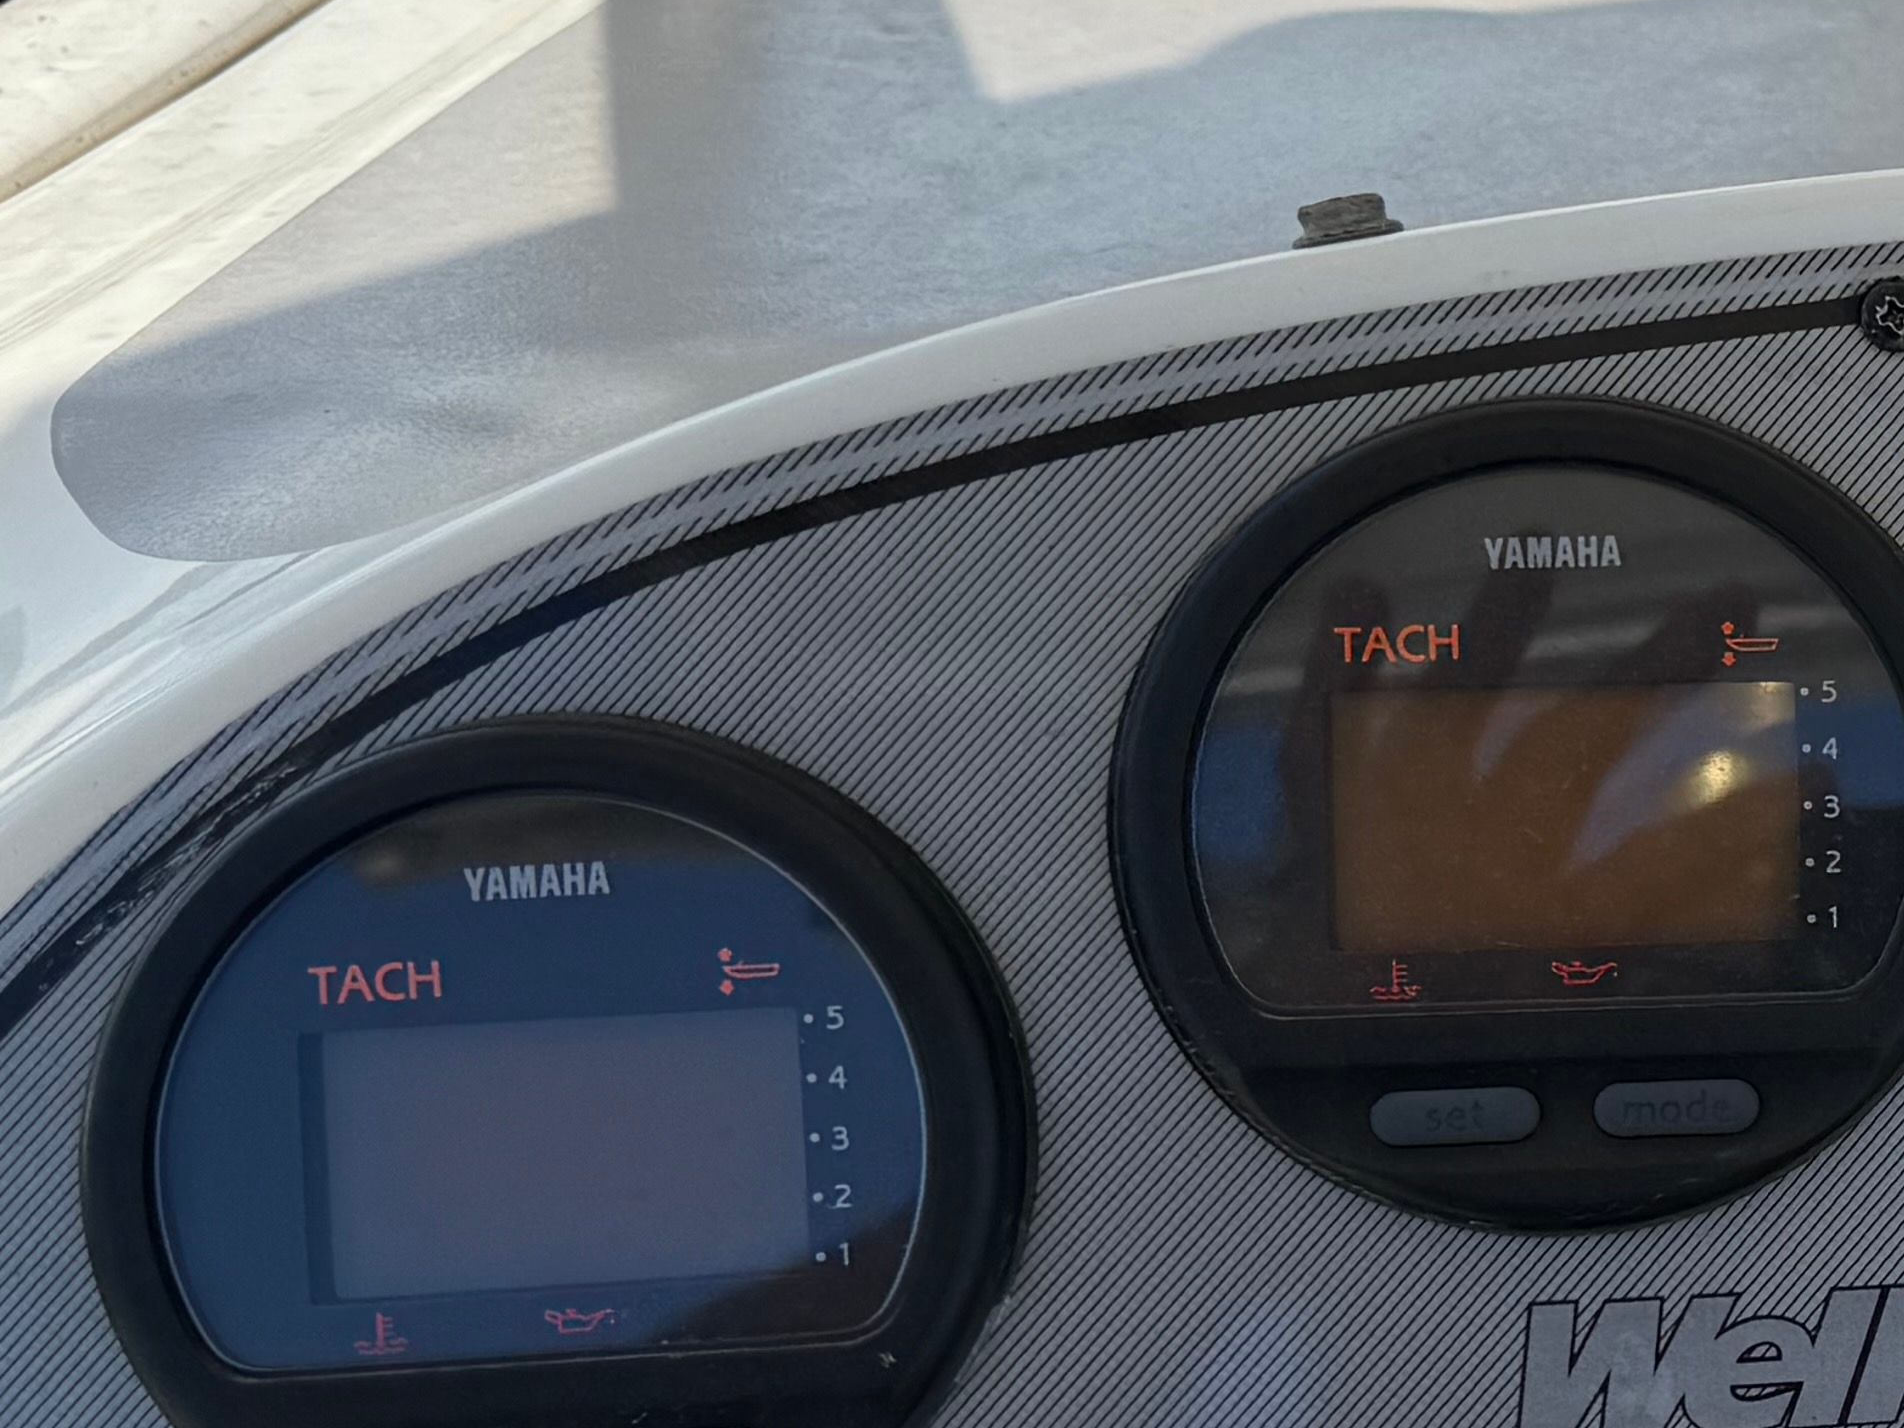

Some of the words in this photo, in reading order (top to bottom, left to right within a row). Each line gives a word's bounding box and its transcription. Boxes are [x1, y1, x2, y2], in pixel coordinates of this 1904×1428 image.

[1484, 535, 1622, 570] YAMAHA
[1333, 625, 1461, 663] TACH
[1822, 681, 1838, 703] 5
[1822, 738, 1840, 760] 4
[1824, 796, 1842, 818] 3
[1825, 852, 1843, 873] 2
[463, 861, 611, 902] YAMAHA
[1828, 907, 1839, 928] 1
[307, 960, 443, 1005] TACH
[825, 1006, 846, 1032] 5
[827, 1065, 848, 1090] 4
[1424, 1099, 1484, 1132] set
[1622, 1089, 1731, 1122] mode
[830, 1127, 851, 1151] 3
[832, 1186, 854, 1210] 2
[838, 1242, 853, 1267] 1
